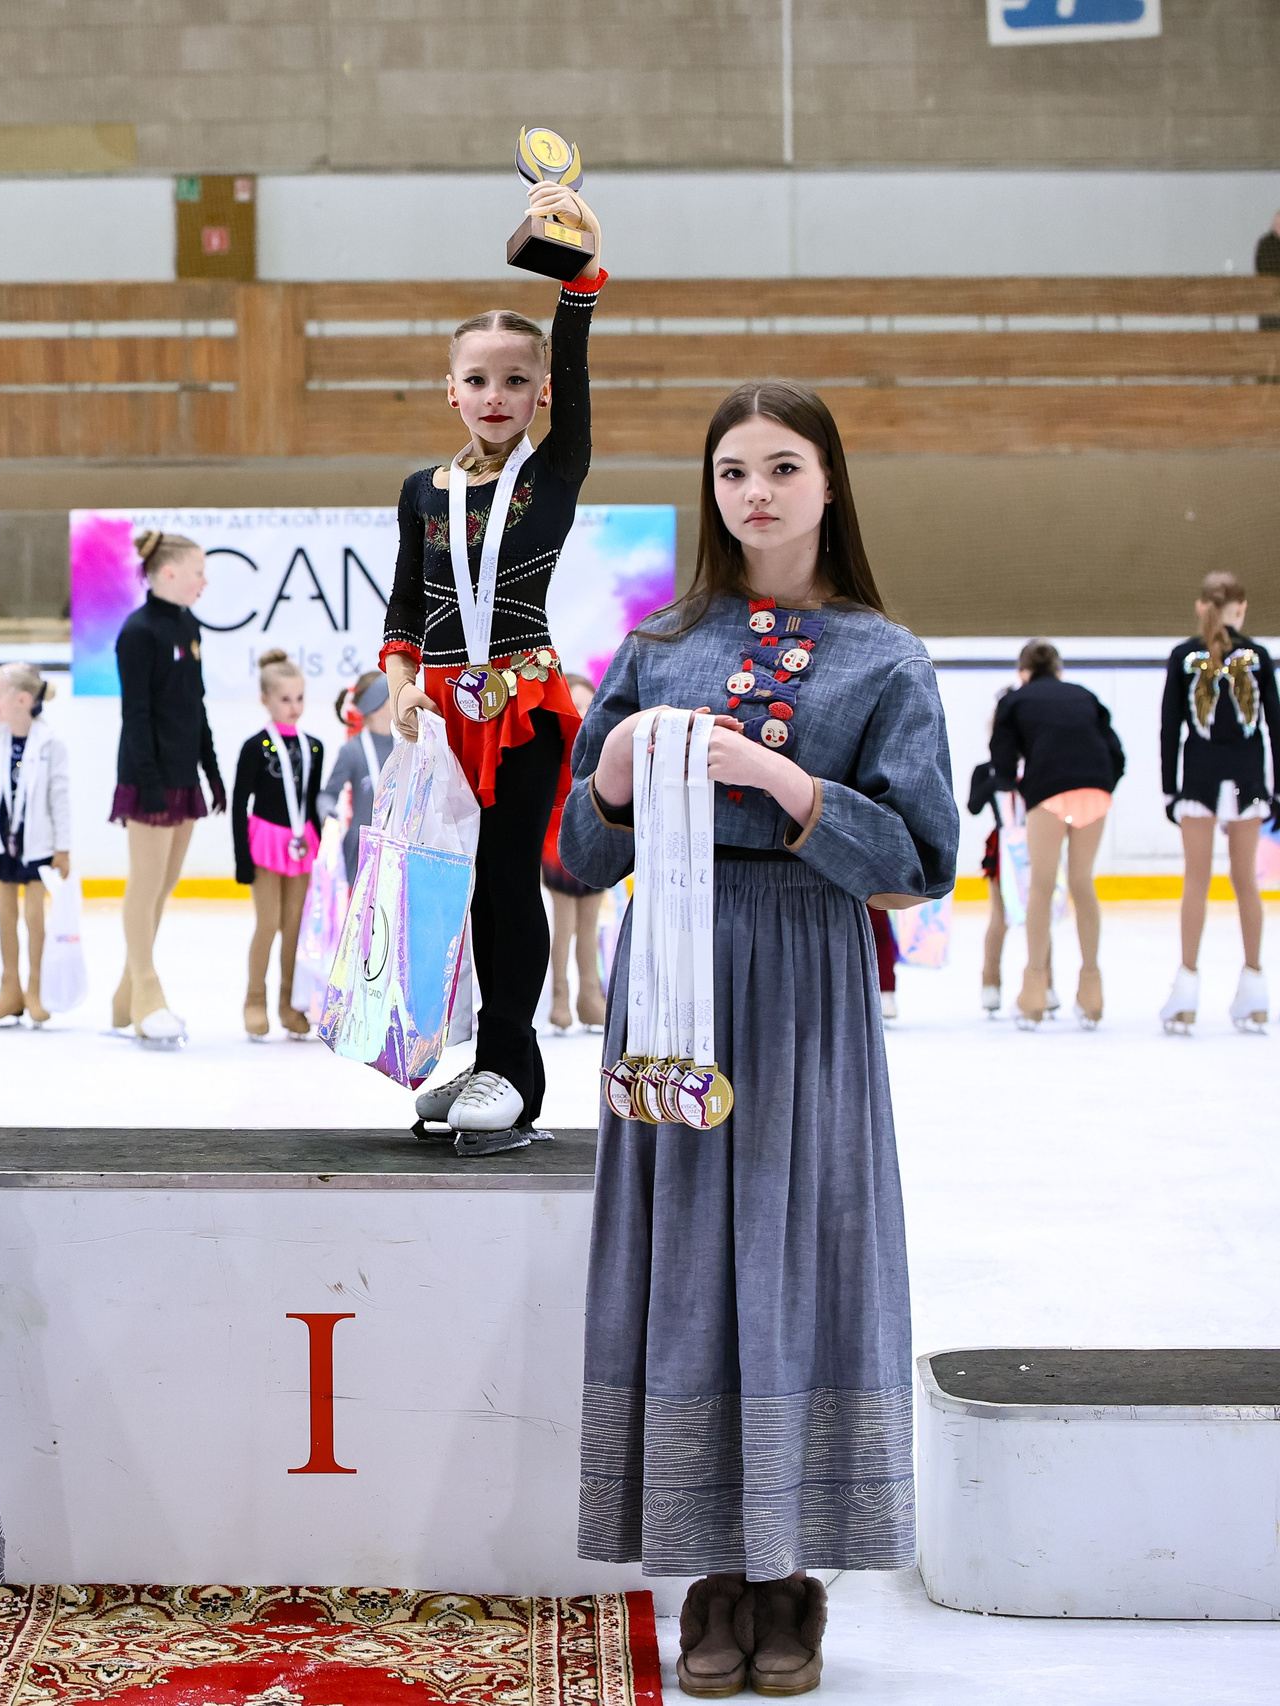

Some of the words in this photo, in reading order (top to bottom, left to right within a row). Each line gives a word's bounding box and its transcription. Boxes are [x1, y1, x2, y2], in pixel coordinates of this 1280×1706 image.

[481, 557, 489, 581] CANDY
[488, 557, 496, 581] КУБОК
[198, 548, 388, 632] CAN
[337, 644, 363, 677] &
[484, 692, 493, 707] 1
[672, 832, 680, 859] КУБОК
[701, 831, 709, 859] КУБОК
[696, 1000, 704, 1027] CANDY
[704, 999, 712, 1026] КУБОК
[708, 1096, 717, 1113] 1
[285, 1313, 357, 1474] I
